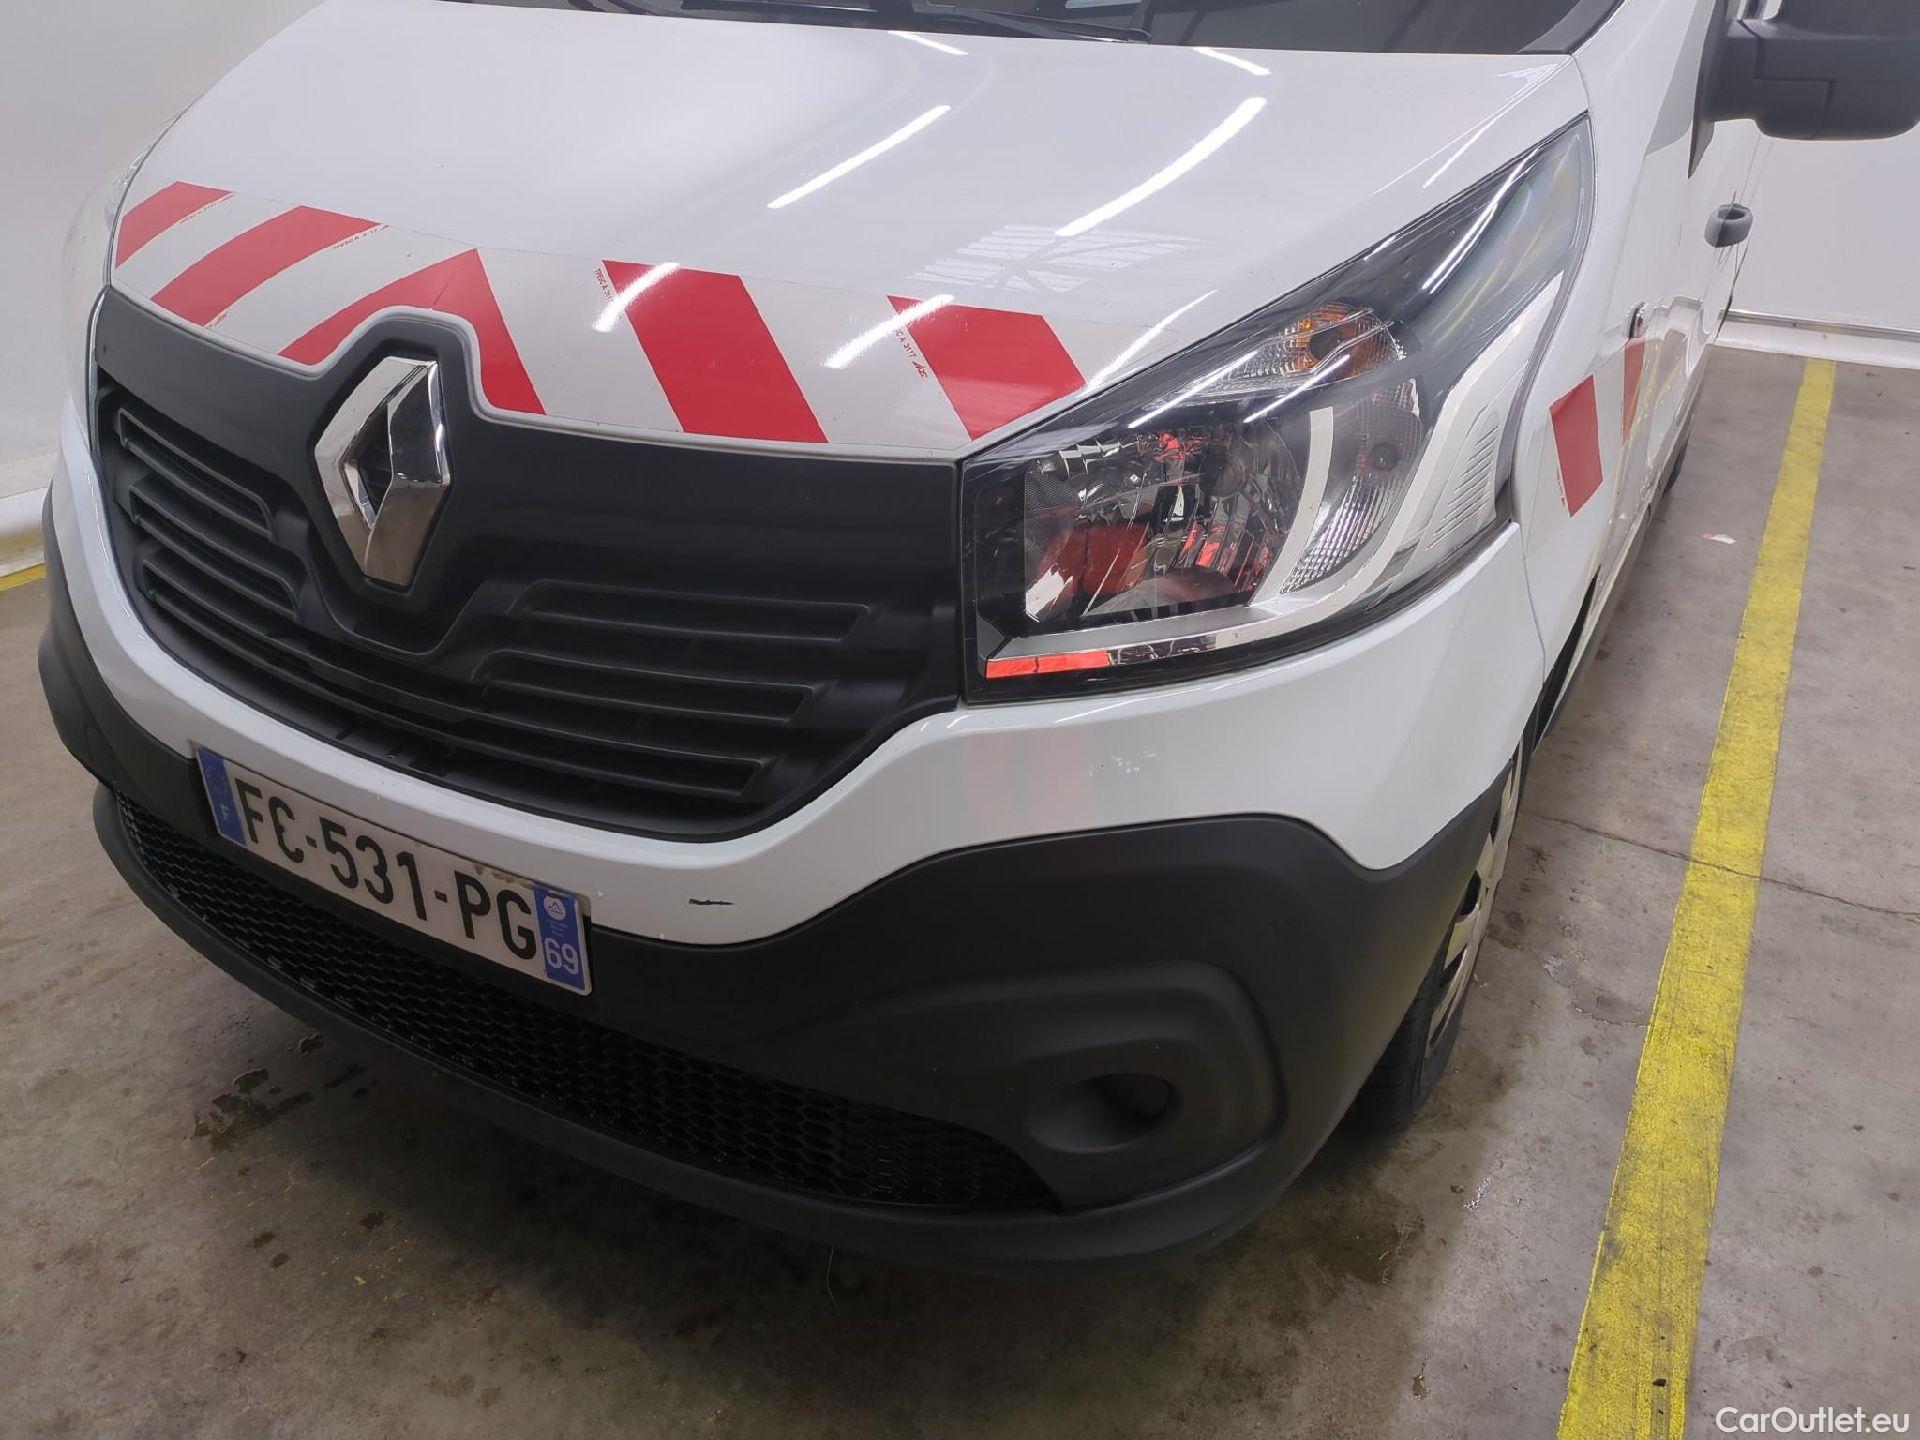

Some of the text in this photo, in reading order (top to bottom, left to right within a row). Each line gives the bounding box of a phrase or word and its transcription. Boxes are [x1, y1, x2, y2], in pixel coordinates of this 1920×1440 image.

[220, 803, 230, 822] F
[235, 778, 536, 959] FC-531-PG
[545, 938, 579, 975] 69
